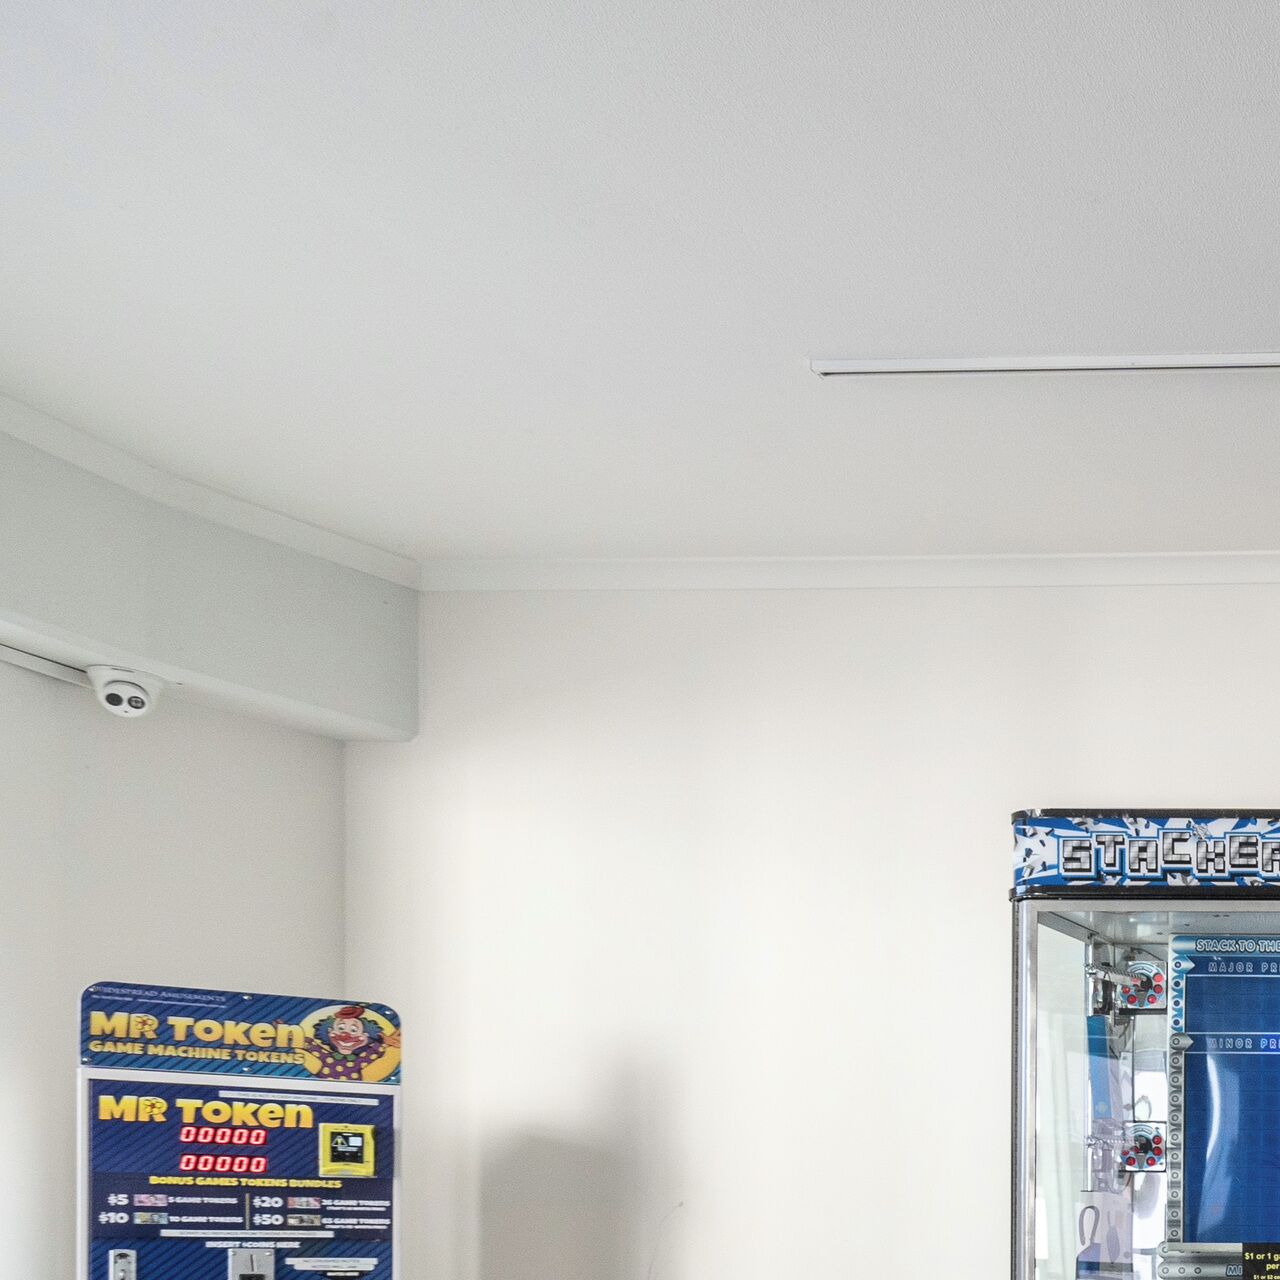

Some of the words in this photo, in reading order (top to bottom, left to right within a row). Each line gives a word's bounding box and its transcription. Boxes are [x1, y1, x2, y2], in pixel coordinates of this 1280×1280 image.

[1196, 939, 1237, 952] STACK
[1237, 939, 1257, 952] TO
[1208, 962, 1254, 973] MAJOR
[89, 1010, 160, 1040] MR
[1209, 1038, 1253, 1049] MINOR
[88, 1039, 145, 1055] GAME
[146, 1044, 232, 1060] MACHINE
[235, 1050, 306, 1065] TOKENS
[98, 1094, 168, 1123] MR
[179, 1126, 267, 1145] 00000
[179, 1153, 267, 1174] 00000
[148, 1175, 194, 1185] BONUS
[195, 1176, 239, 1186] GAMES
[239, 1177, 288, 1188] TOKENS
[289, 1179, 343, 1189] BUNDLES
[108, 1194, 129, 1206] $5
[253, 1196, 284, 1208] $20
[98, 1211, 130, 1225] $10
[253, 1214, 284, 1226] $50
[1244, 1252, 1254, 1261] $1
[1266, 1263, 1279, 1271] per
